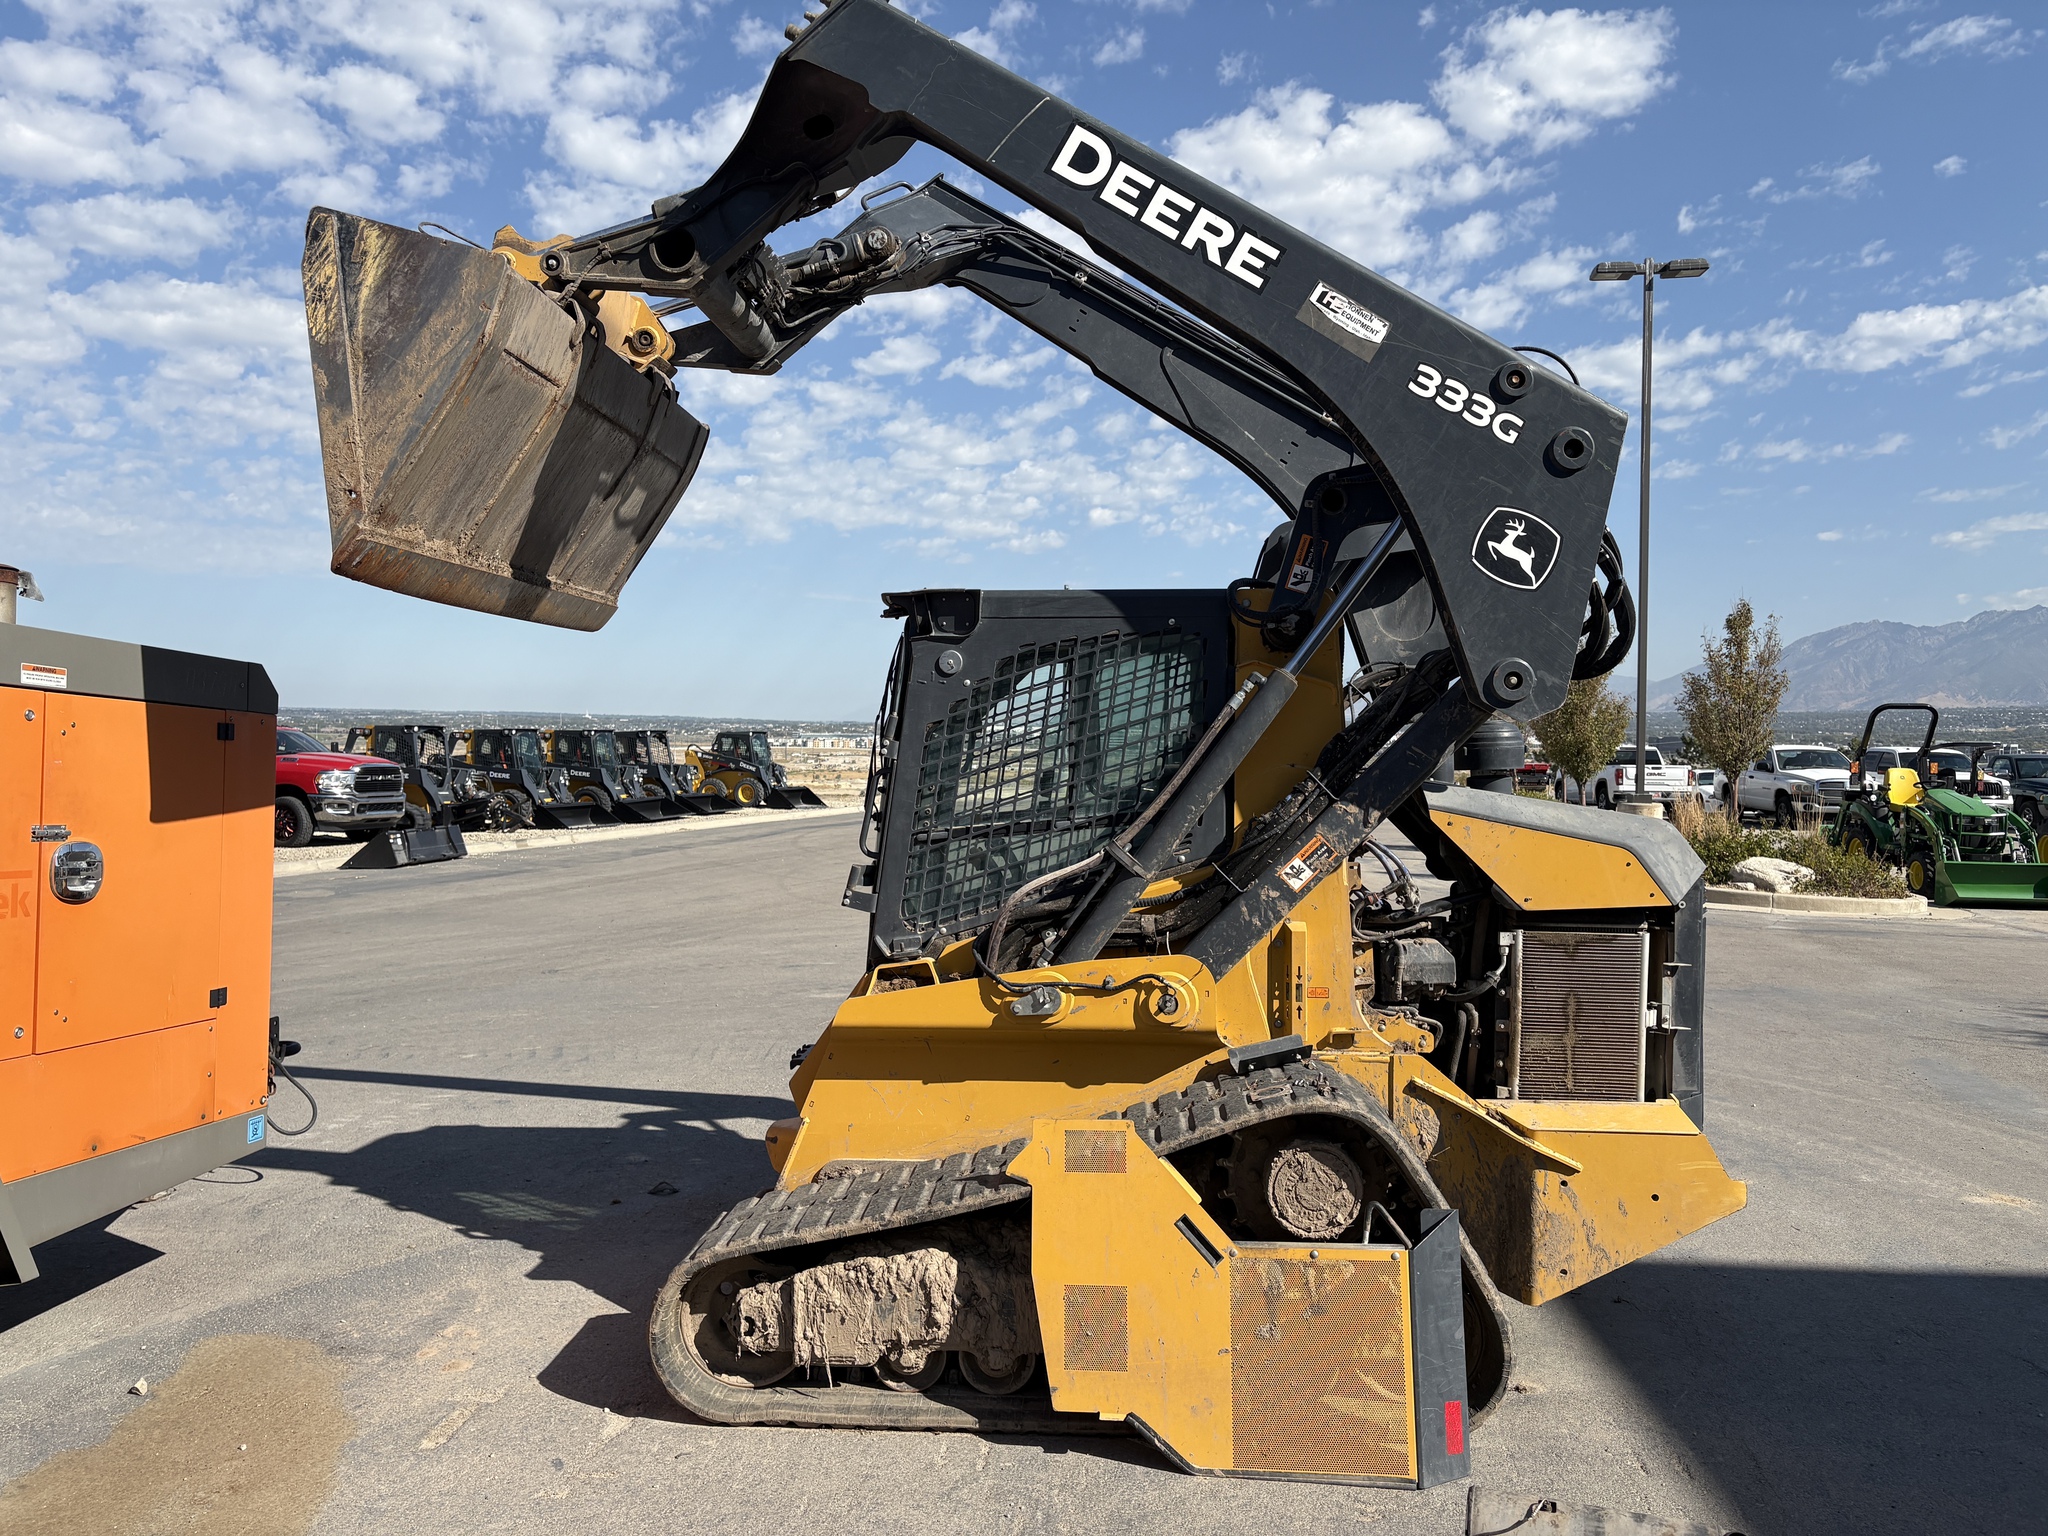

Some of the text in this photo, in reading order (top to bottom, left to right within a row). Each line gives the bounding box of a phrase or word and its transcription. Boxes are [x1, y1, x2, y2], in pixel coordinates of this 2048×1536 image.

[1050, 124, 1281, 289] DEERE
[1341, 310, 1380, 337] EQUIPMENT
[1407, 363, 1525, 445] 333G
[489, 771, 511, 779] DEERE
[570, 769, 591, 777] DEERE
[1317, 845, 1328, 856] Area
